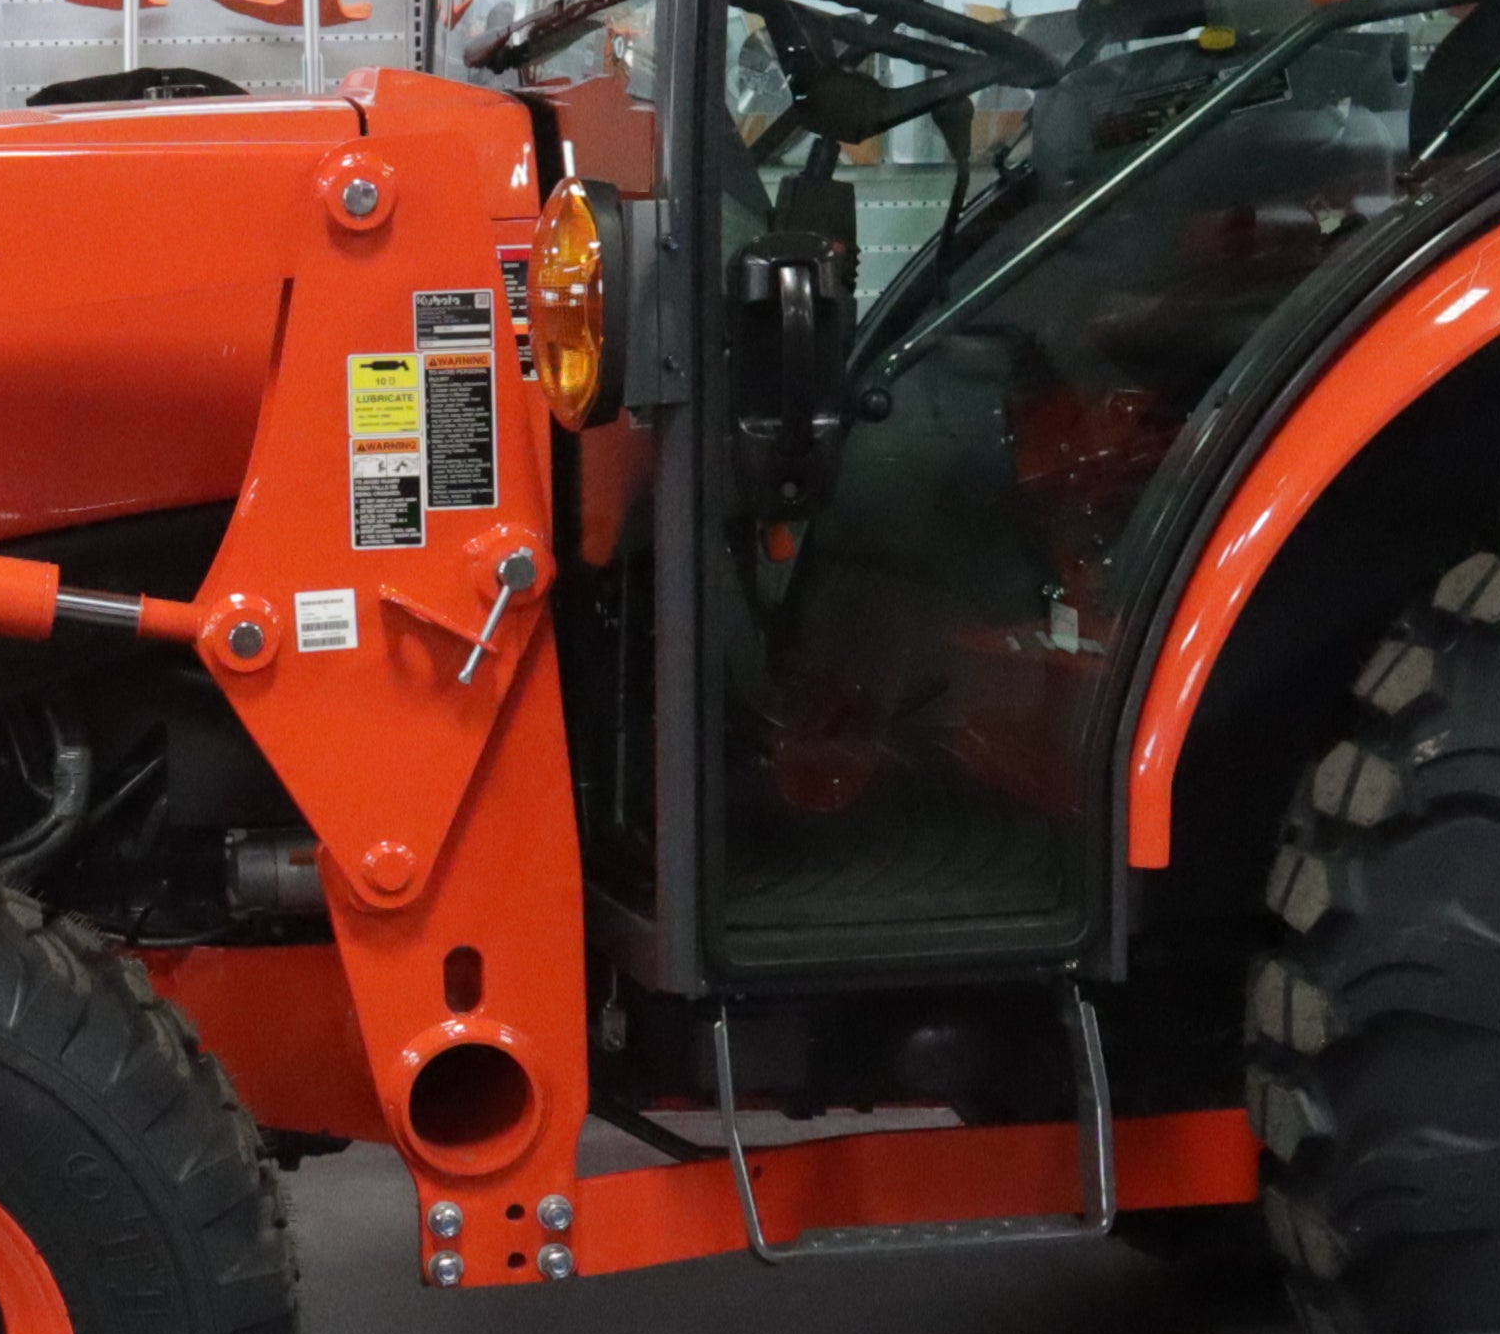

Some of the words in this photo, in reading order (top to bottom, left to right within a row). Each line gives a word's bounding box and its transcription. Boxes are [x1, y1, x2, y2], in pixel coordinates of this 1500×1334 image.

[416, 294, 461, 307] Kubota
[437, 355, 488, 366] WARNING
[356, 393, 414, 404] LUBRICATE
[366, 440, 417, 451] WARNING
